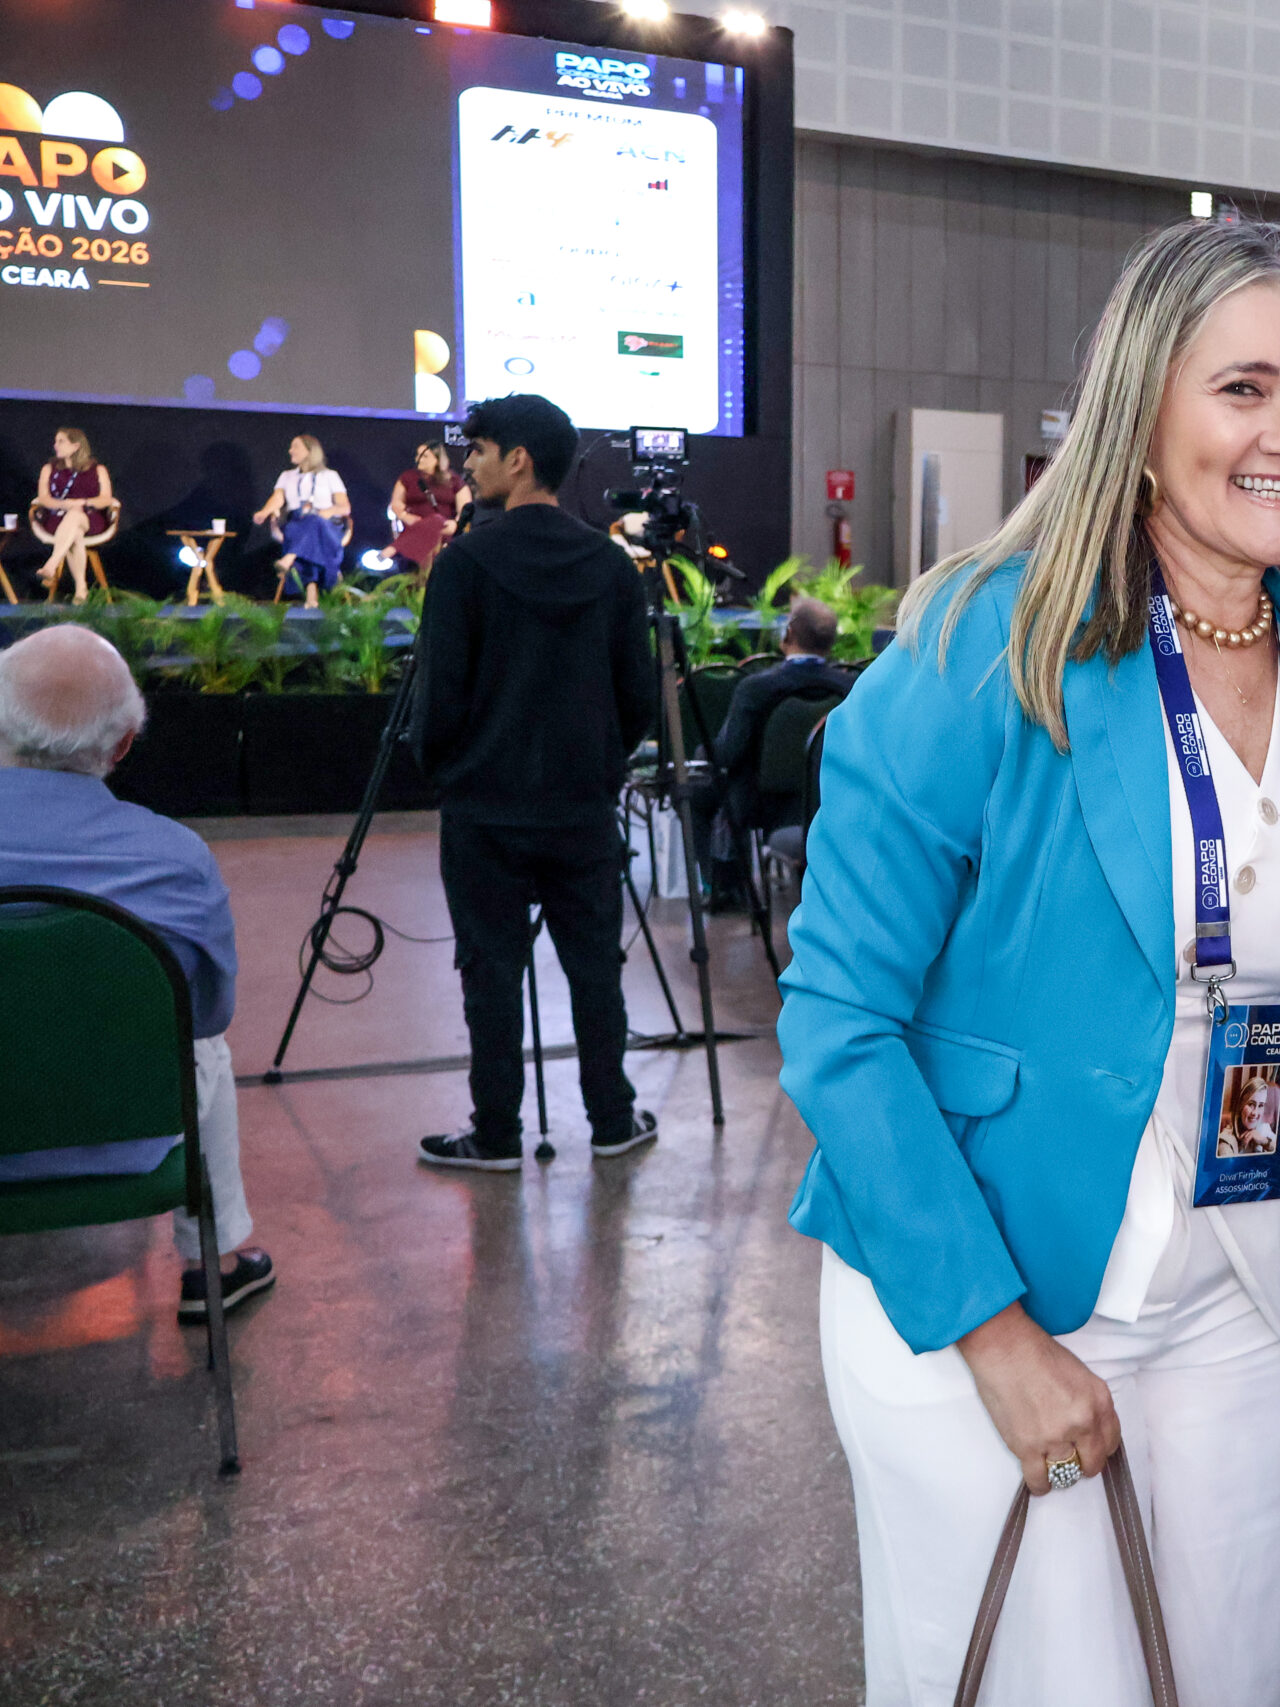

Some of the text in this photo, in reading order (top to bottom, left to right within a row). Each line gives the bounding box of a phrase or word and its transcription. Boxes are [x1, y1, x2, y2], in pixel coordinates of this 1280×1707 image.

[556, 52, 651, 80] PAPO
[557, 75, 592, 89] AO
[592, 79, 651, 97] VIVO
[23, 190, 149, 234] VIVO
[71, 236, 150, 265] 2026
[1, 265, 90, 290] CEARÁ
[1154, 595, 1170, 633] CONDO
[1175, 713, 1191, 755] PAPO
[1183, 713, 1198, 754] CONDO
[1200, 839, 1211, 885] PAPO
[1208, 839, 1218, 884] CONDO
